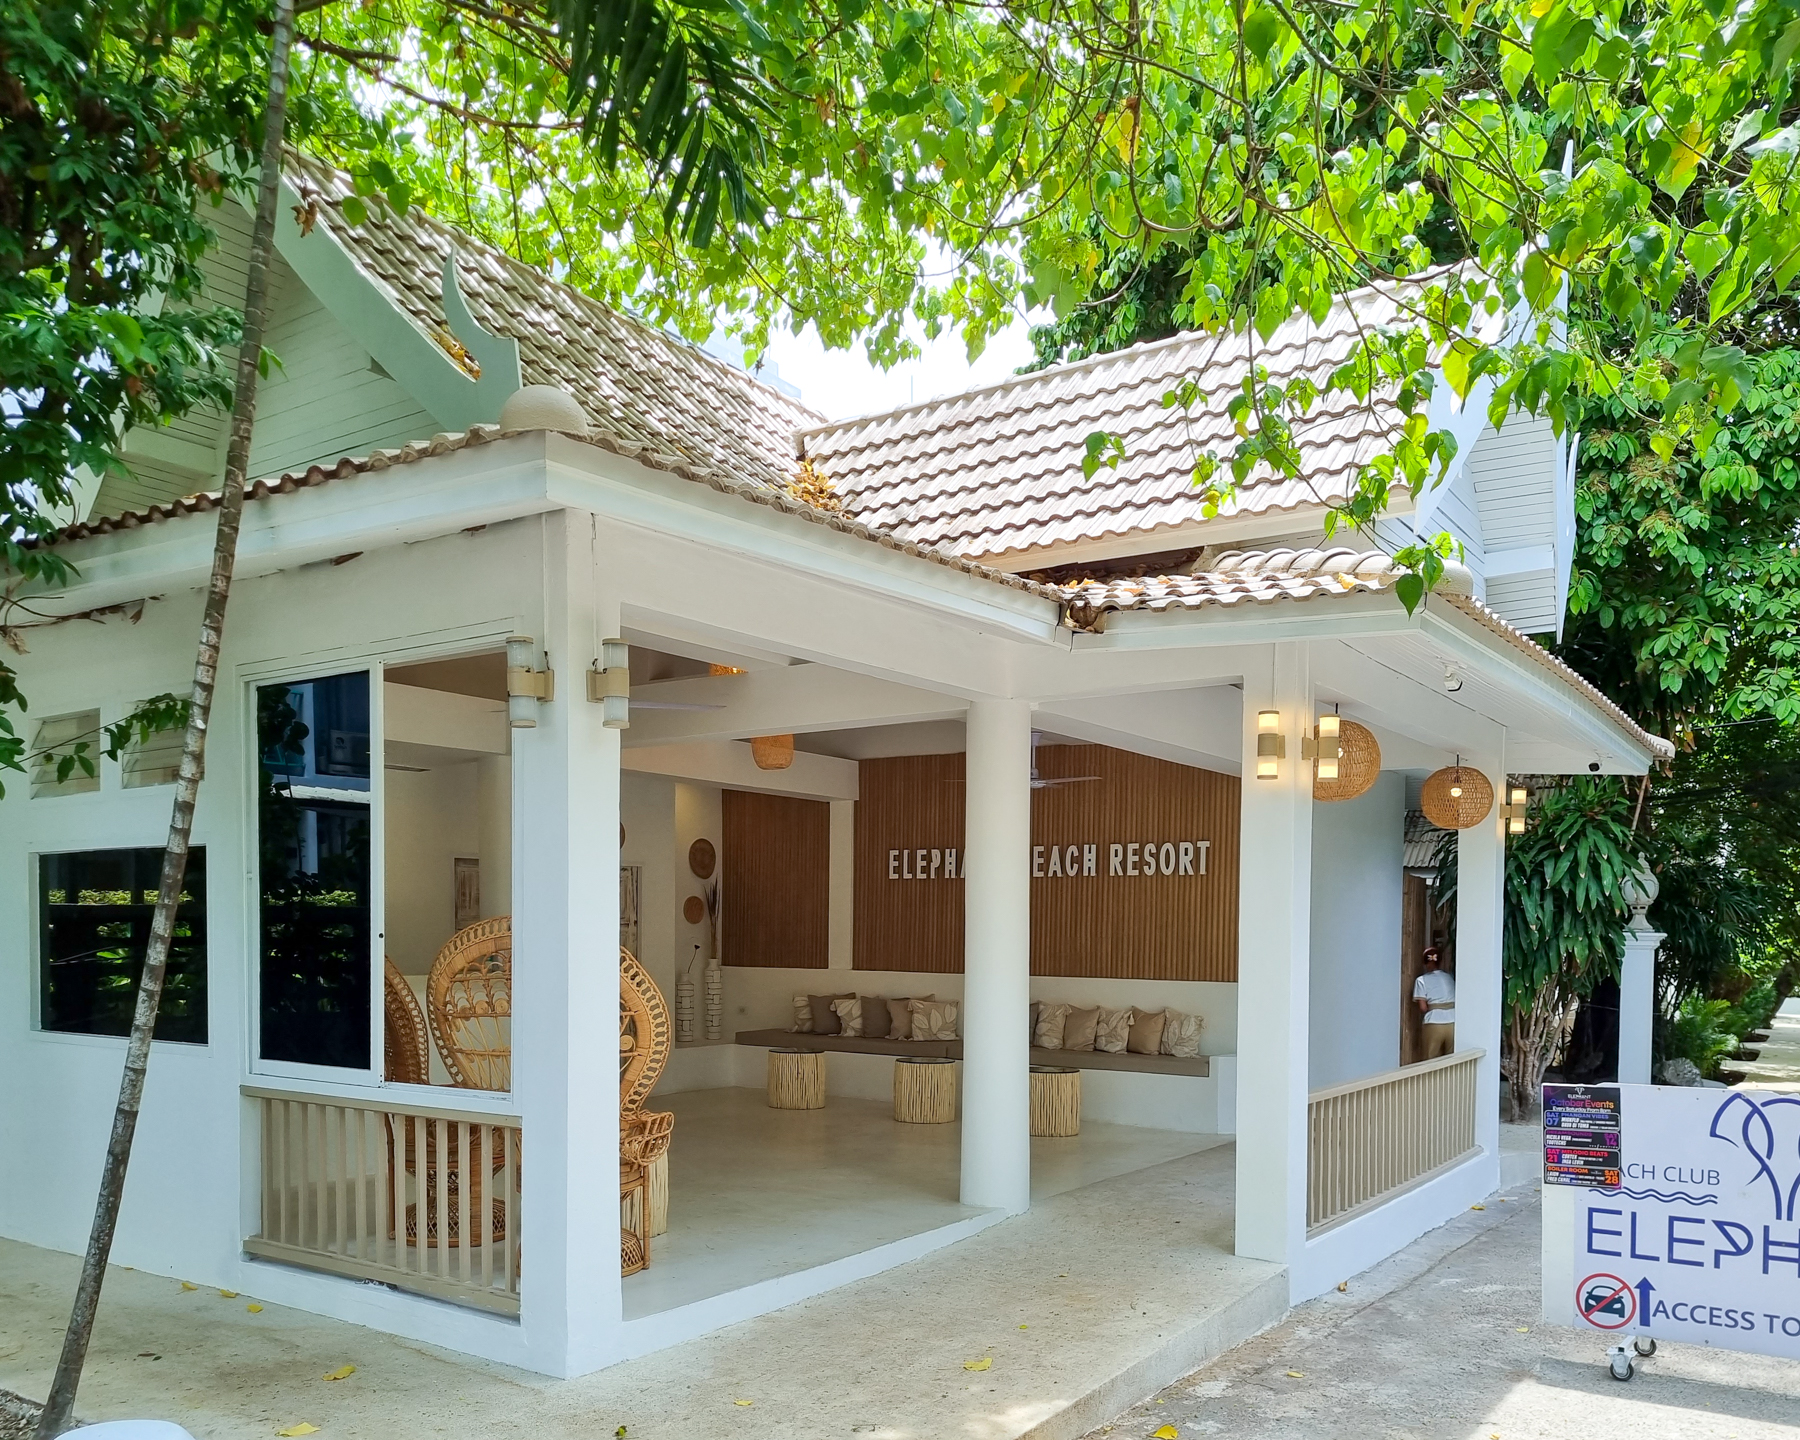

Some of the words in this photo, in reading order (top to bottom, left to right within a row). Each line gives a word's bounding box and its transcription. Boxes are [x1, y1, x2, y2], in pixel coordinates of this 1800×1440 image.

[1033, 844, 1097, 878] EACH
[1109, 840, 1211, 877] RESORT
[1550, 1099, 1584, 1107] October
[1585, 1100, 1614, 1109] Events
[1663, 1166, 1720, 1186] CLUB
[1587, 1206, 1800, 1279] ELEPH
[1652, 1299, 1755, 1331] ACCESS
[1763, 1313, 1800, 1337] TO
